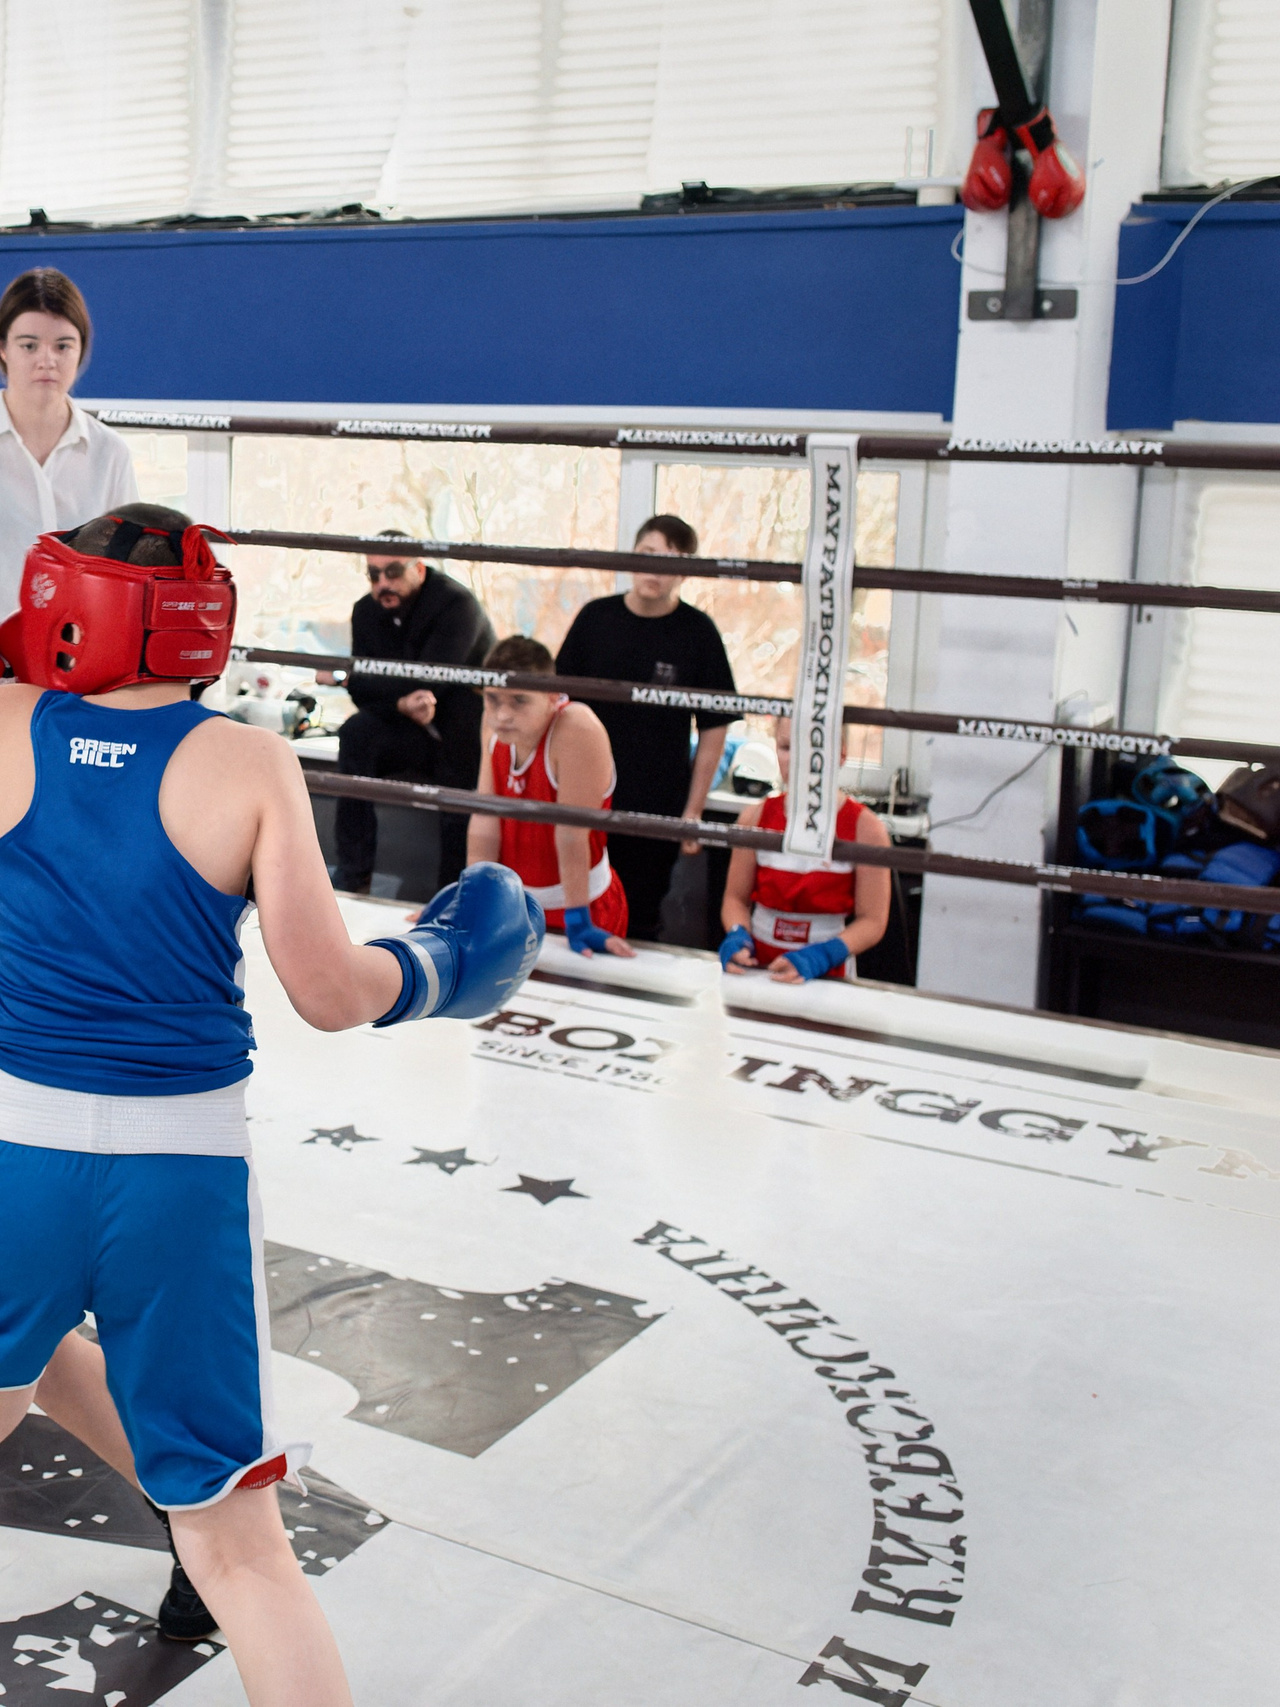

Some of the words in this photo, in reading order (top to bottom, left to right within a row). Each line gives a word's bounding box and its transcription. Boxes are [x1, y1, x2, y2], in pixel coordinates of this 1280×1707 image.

[804, 464, 840, 832] MAYFATBOXINGGYM
[70, 737, 137, 755] GREEN
[958, 719, 1170, 756] MAYFATBOXINGGYM
[70, 749, 125, 768] HILL
